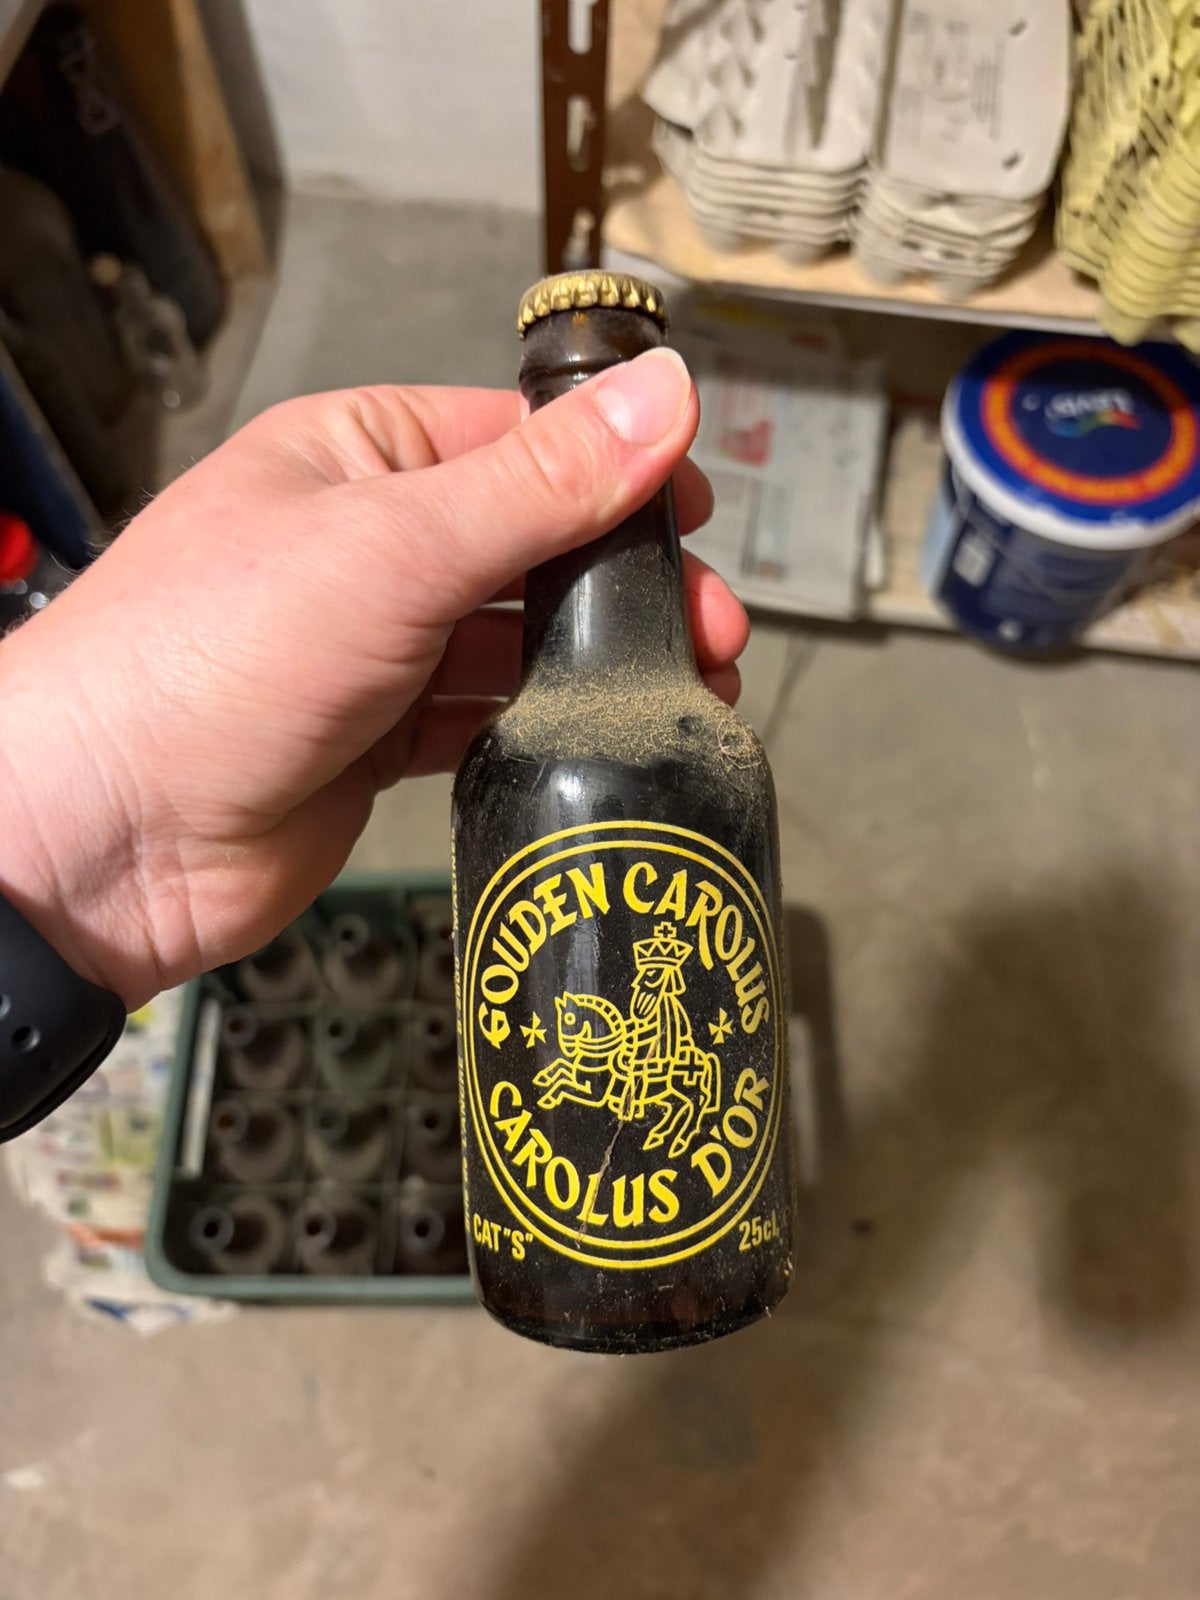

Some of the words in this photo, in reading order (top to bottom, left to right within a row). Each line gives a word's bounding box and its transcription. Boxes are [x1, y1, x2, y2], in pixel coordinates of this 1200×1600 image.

[478, 862, 611, 1050] GOUDEN
[623, 861, 769, 1034] CAROLUS
[489, 1080, 680, 1228] CAROLUS
[691, 1067, 769, 1198] D'OR
[473, 1212, 502, 1253] CAT
